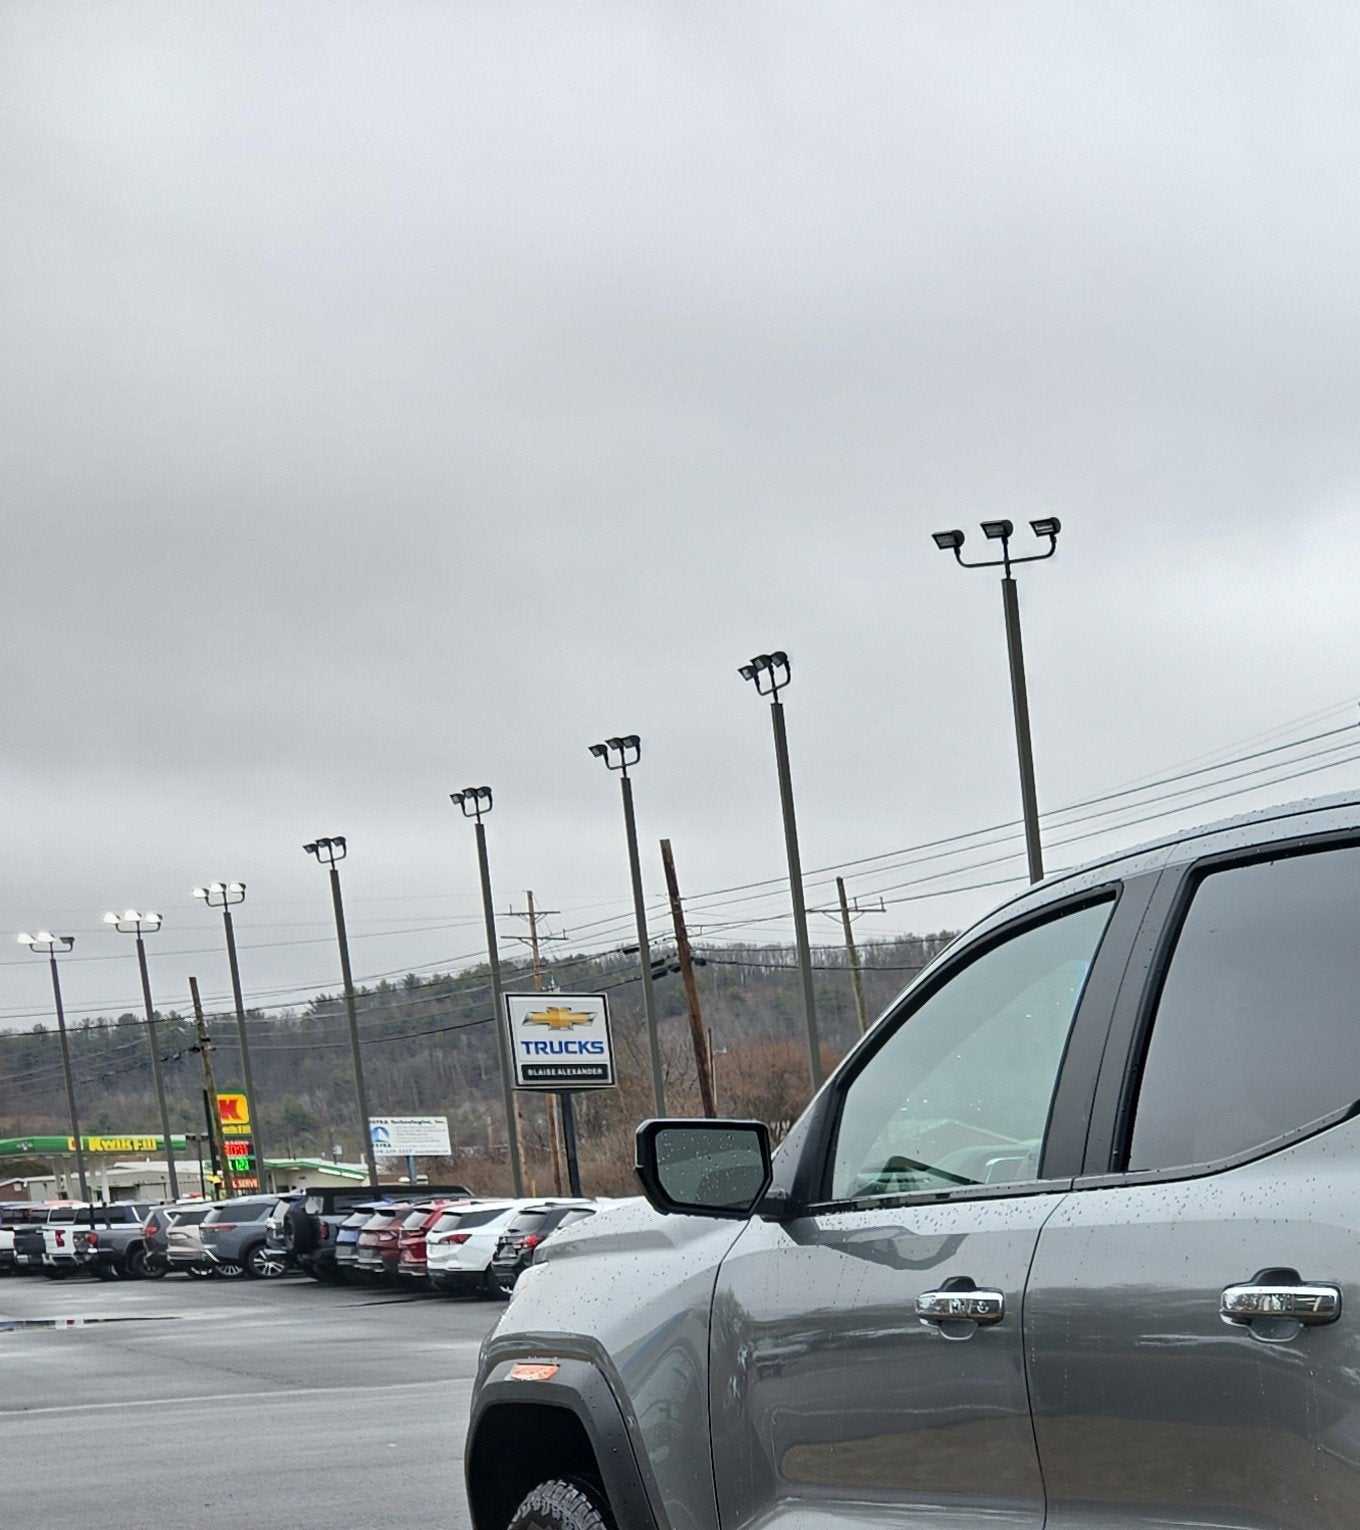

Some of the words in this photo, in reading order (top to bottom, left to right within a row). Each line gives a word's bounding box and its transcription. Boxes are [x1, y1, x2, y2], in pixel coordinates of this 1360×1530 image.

[521, 1040, 605, 1056] TRUCKS
[528, 1067, 556, 1077] BLAISE
[557, 1066, 603, 1077] ALEXANDER
